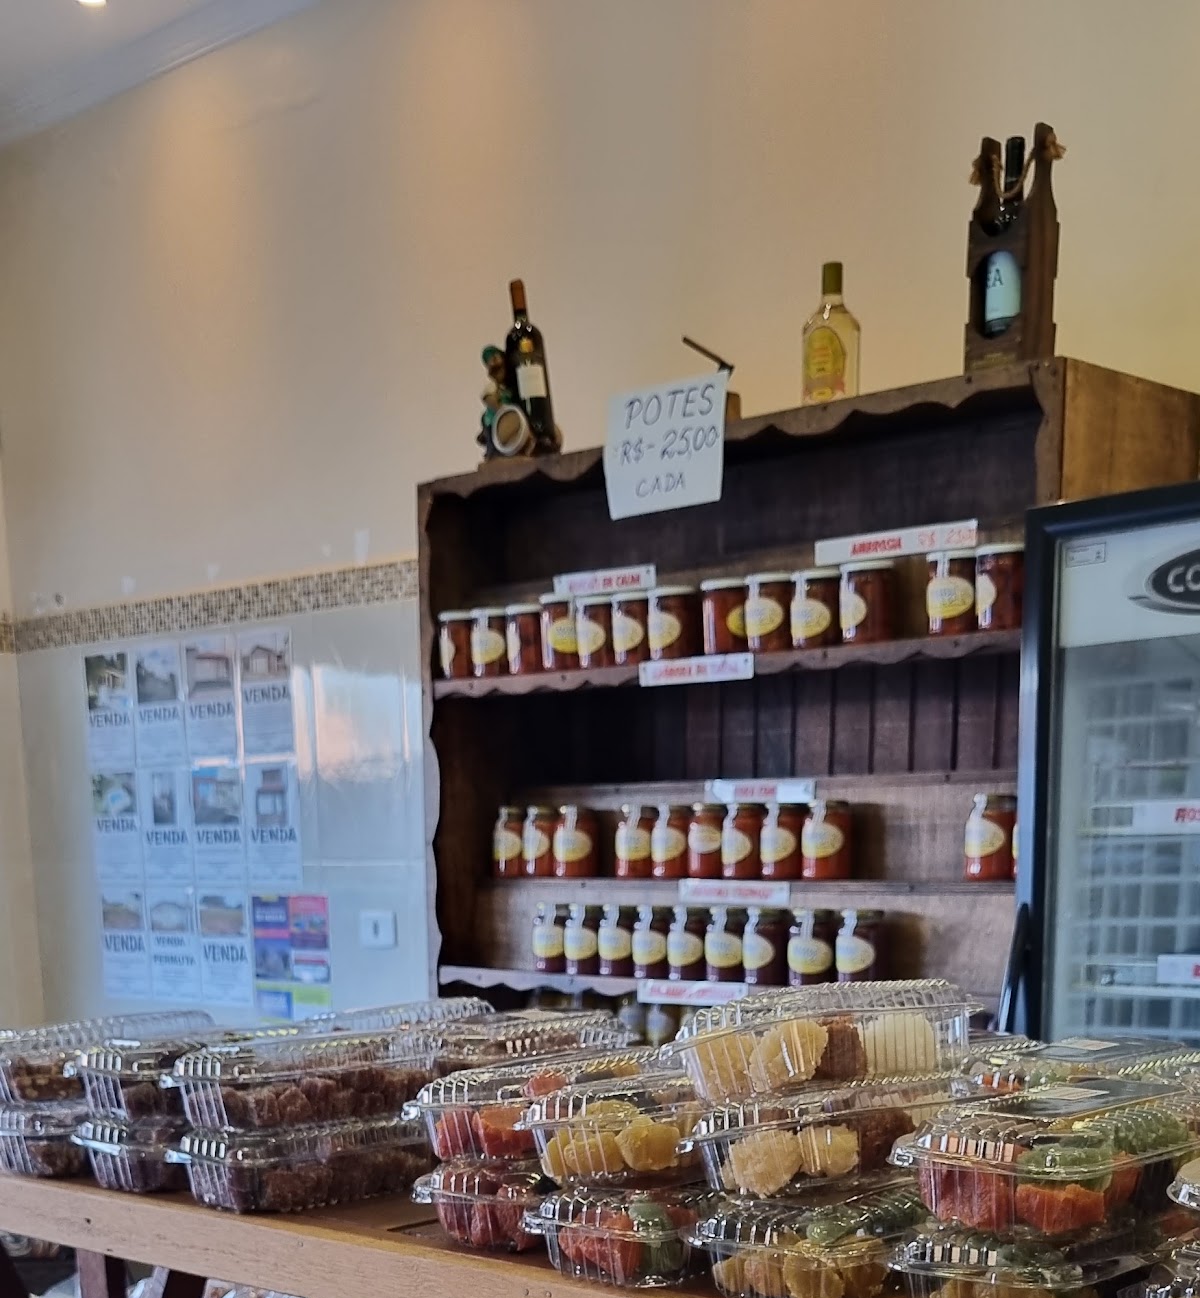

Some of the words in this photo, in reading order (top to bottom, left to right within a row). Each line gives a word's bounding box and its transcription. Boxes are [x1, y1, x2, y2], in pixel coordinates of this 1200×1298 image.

[625, 383, 715, 430] POTES
[635, 472, 687, 498] CADA
[244, 685, 289, 703] VENDA
[139, 706, 180, 723] VENDA
[190, 702, 234, 720] VENDA
[89, 714, 130, 728] VENDA
[97, 819, 137, 833] VENDA
[146, 830, 188, 845] VENDA
[197, 829, 242, 844] VENDA
[252, 827, 297, 844] VENDA
[105, 935, 145, 951] VENDA
[203, 944, 248, 964] VENDA
